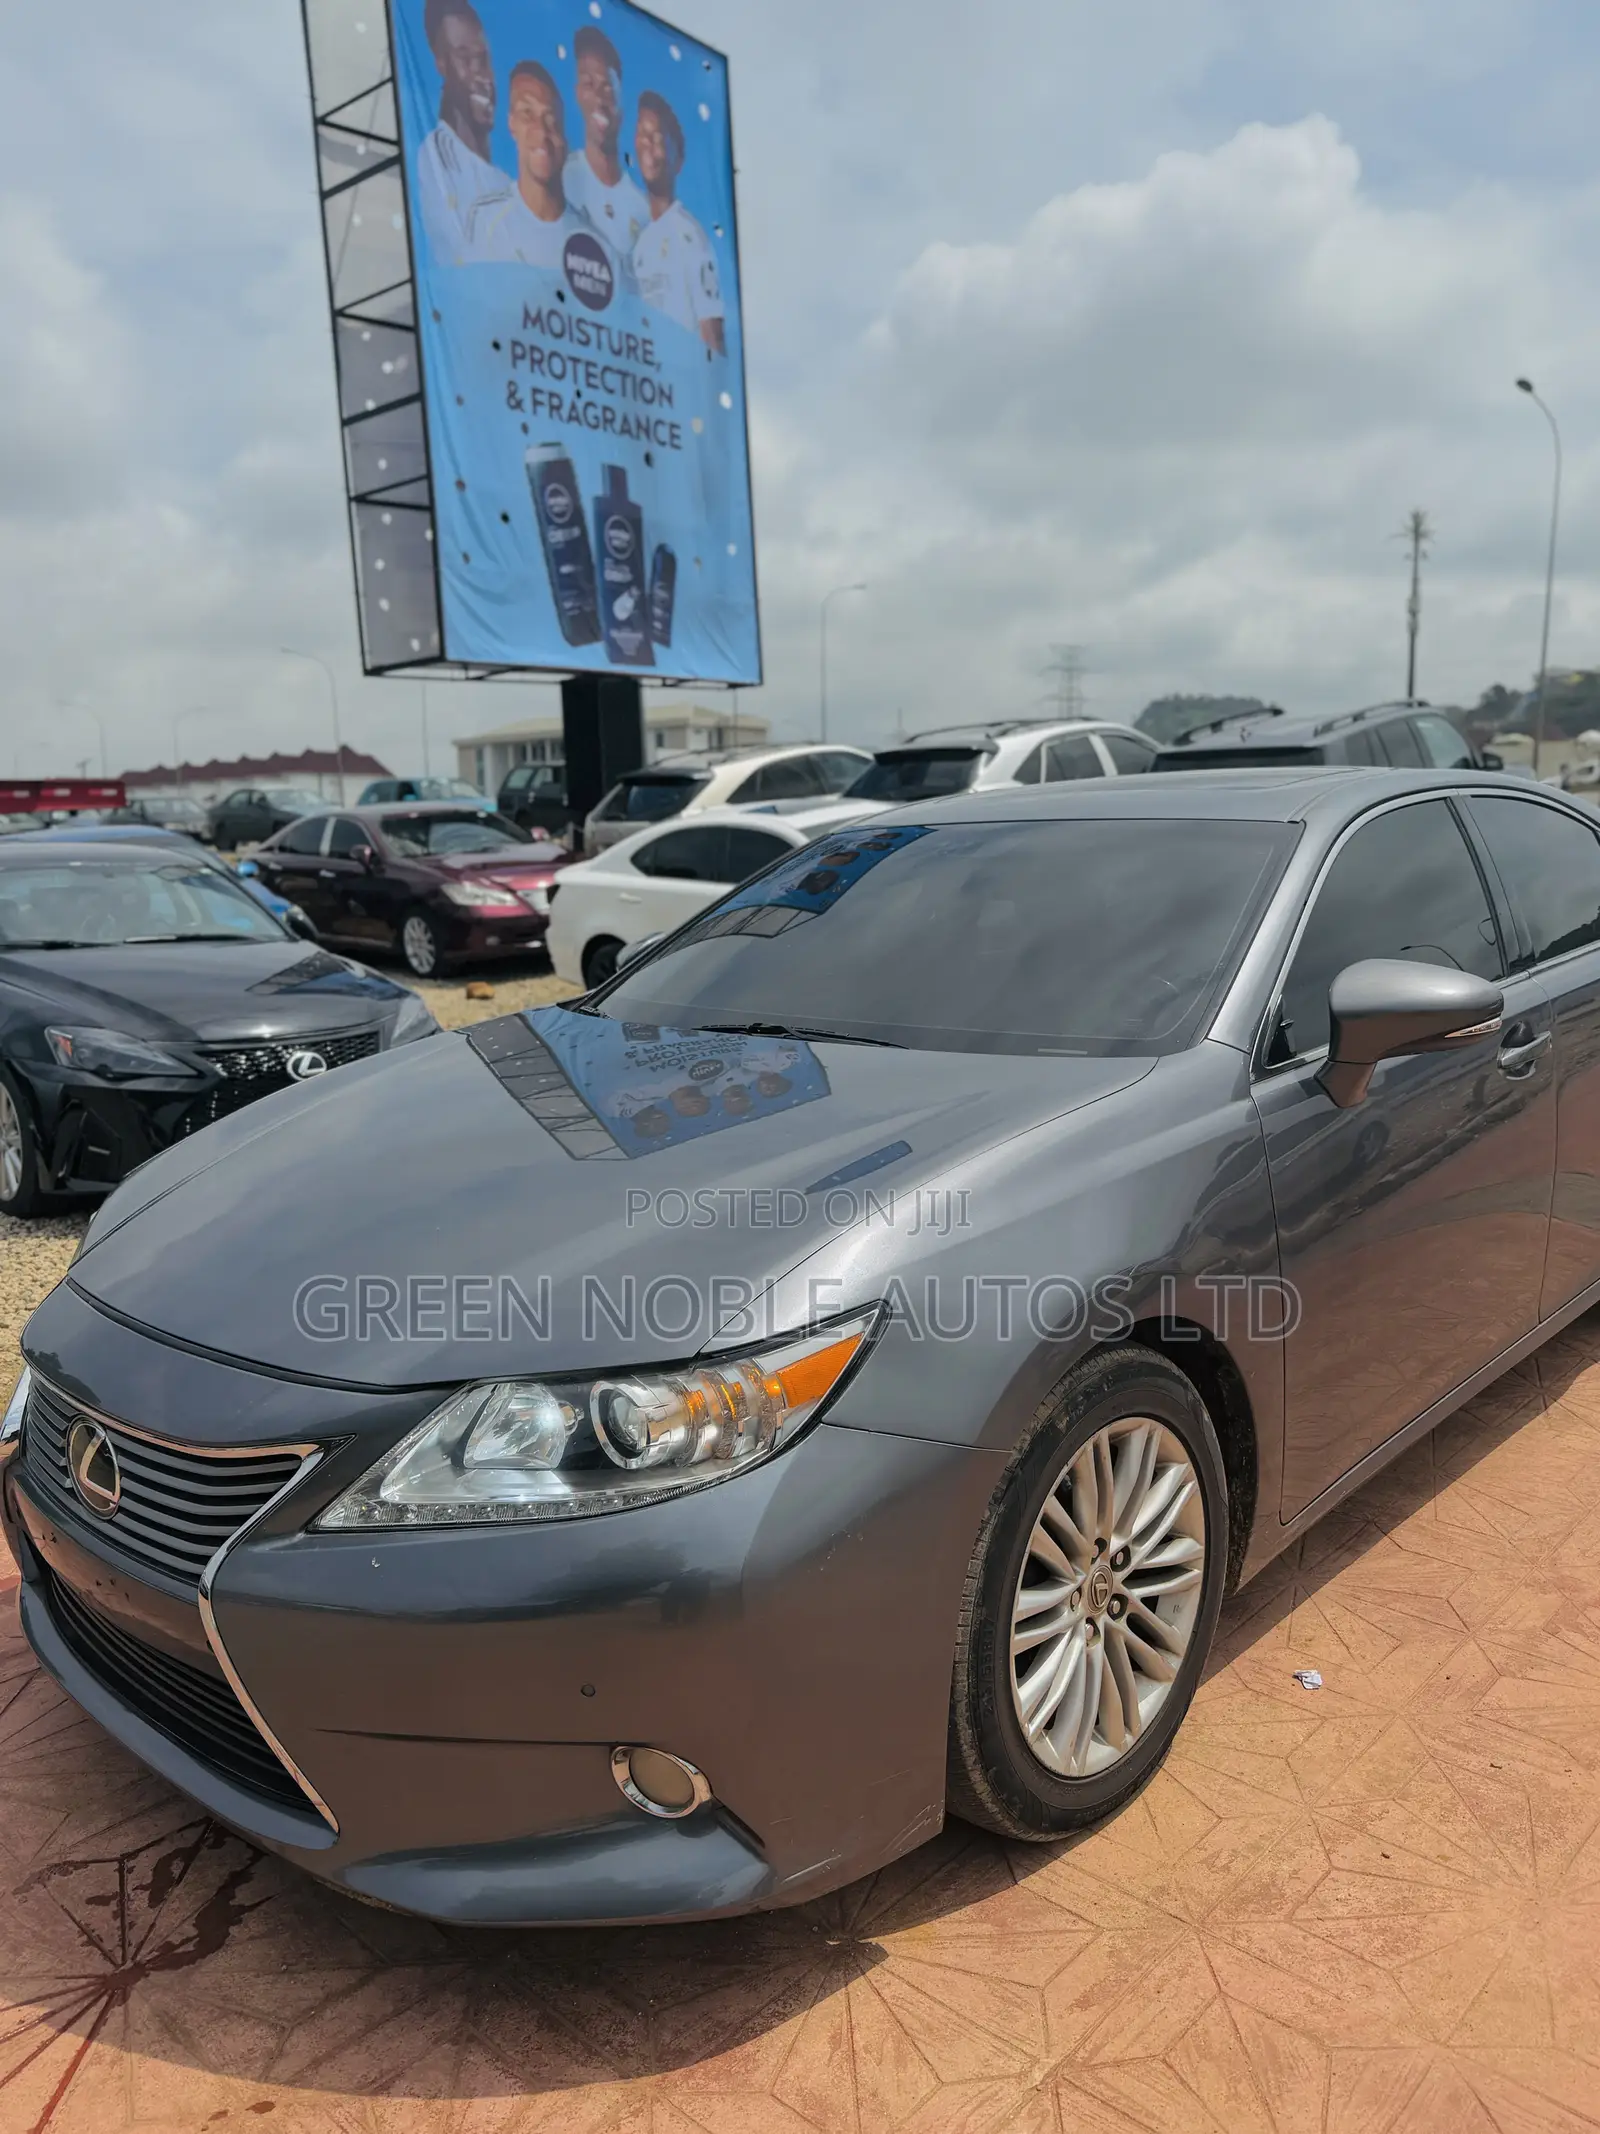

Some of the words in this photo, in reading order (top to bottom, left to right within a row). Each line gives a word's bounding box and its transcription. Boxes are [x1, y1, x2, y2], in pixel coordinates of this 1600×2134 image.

[522, 302, 662, 372] MOISTURE,
[510, 339, 674, 409] PROTECTION
[506, 380, 525, 412] &
[531, 387, 683, 450] FRAGRANCE
